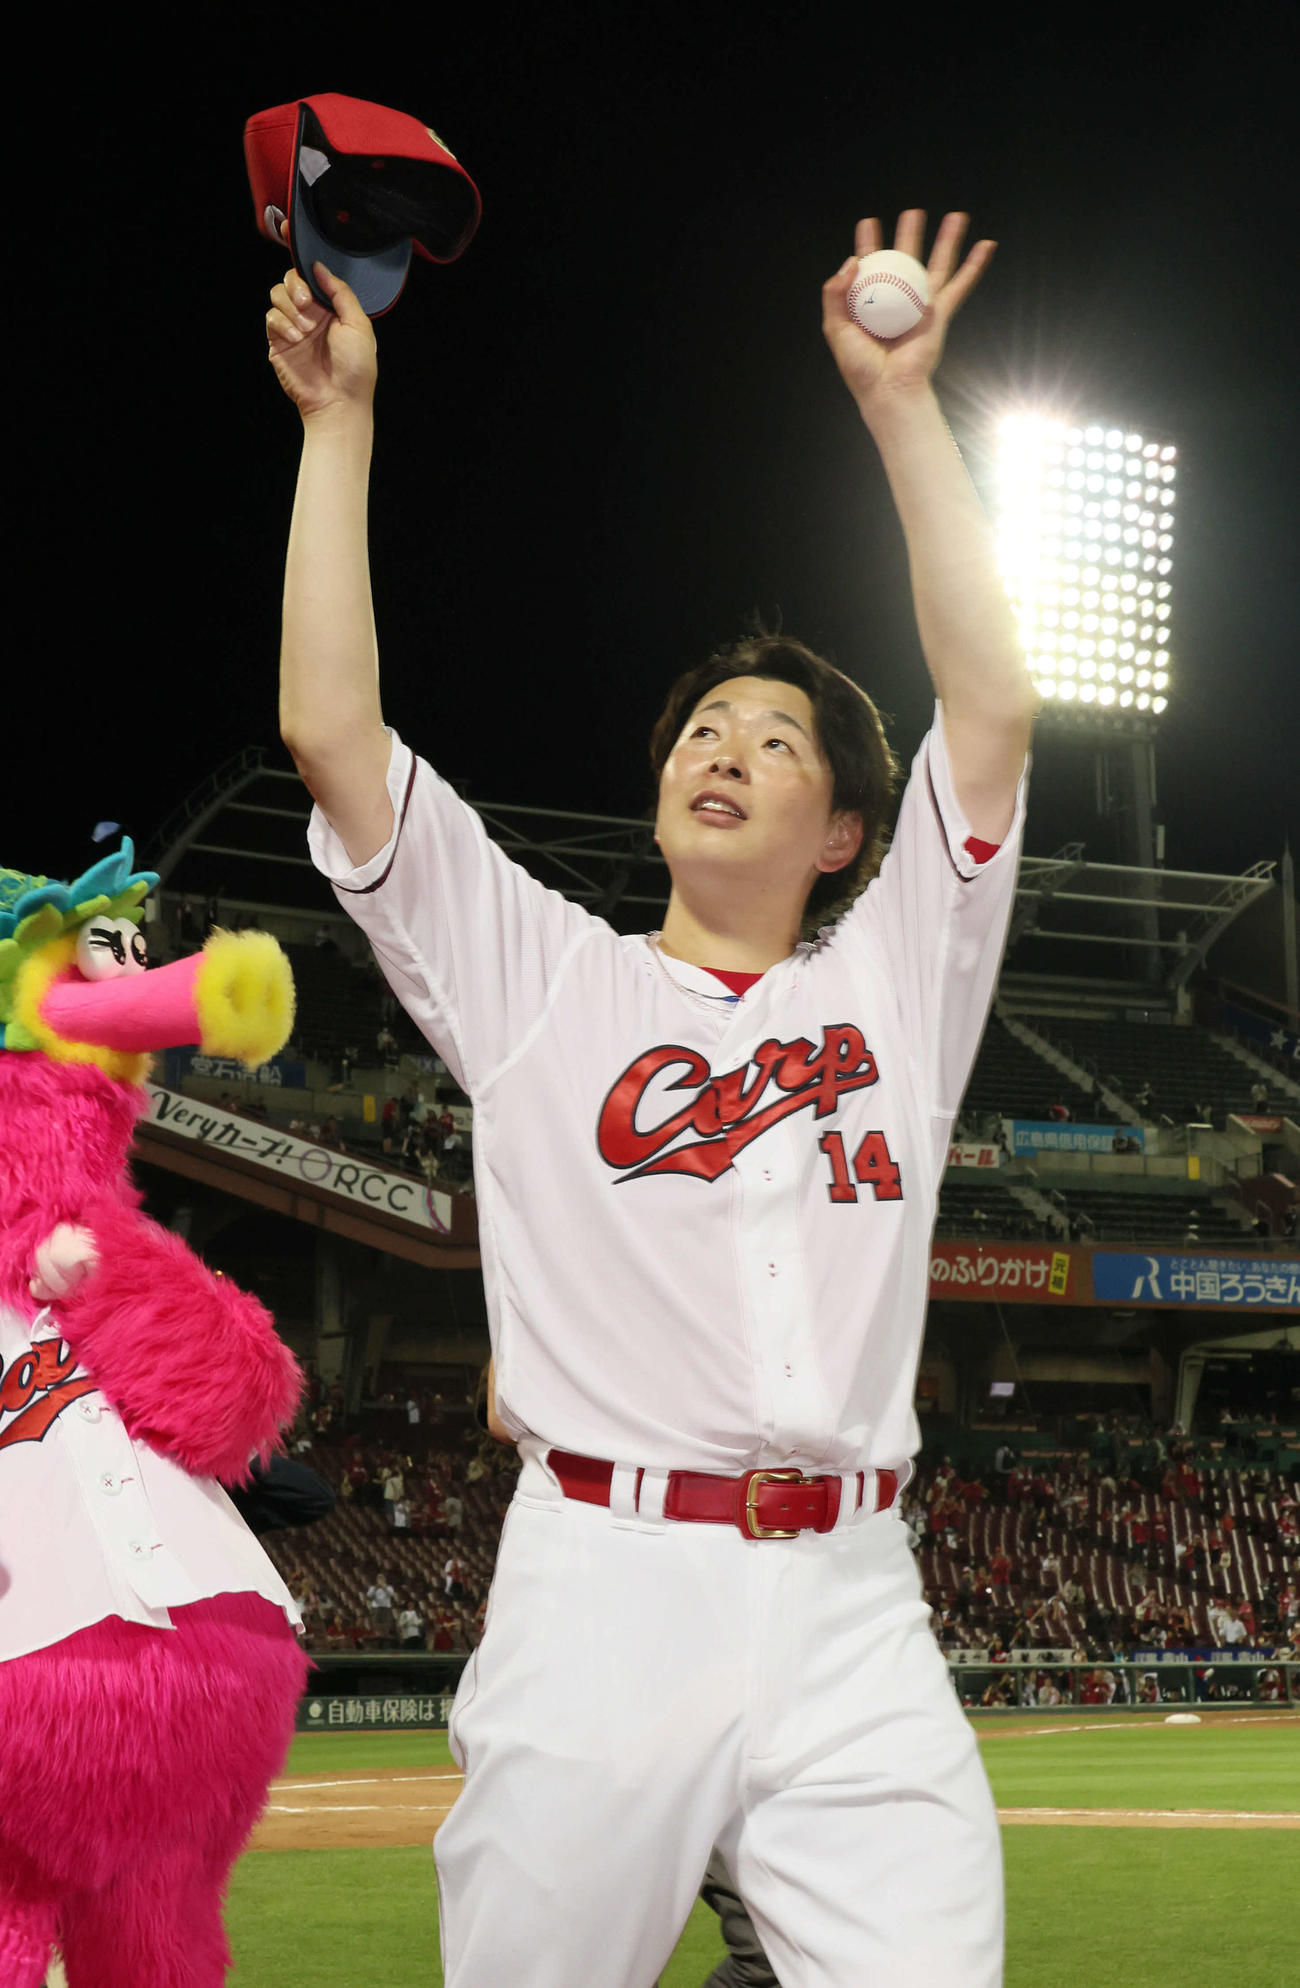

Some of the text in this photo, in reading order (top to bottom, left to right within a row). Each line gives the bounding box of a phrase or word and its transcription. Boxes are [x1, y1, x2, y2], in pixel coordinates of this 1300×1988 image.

[597, 1023, 879, 1184] Carp
[333, 1164, 415, 1212] RCC
[818, 1130, 904, 1204] 14
[930, 1255, 1049, 1288] のふりかけ
